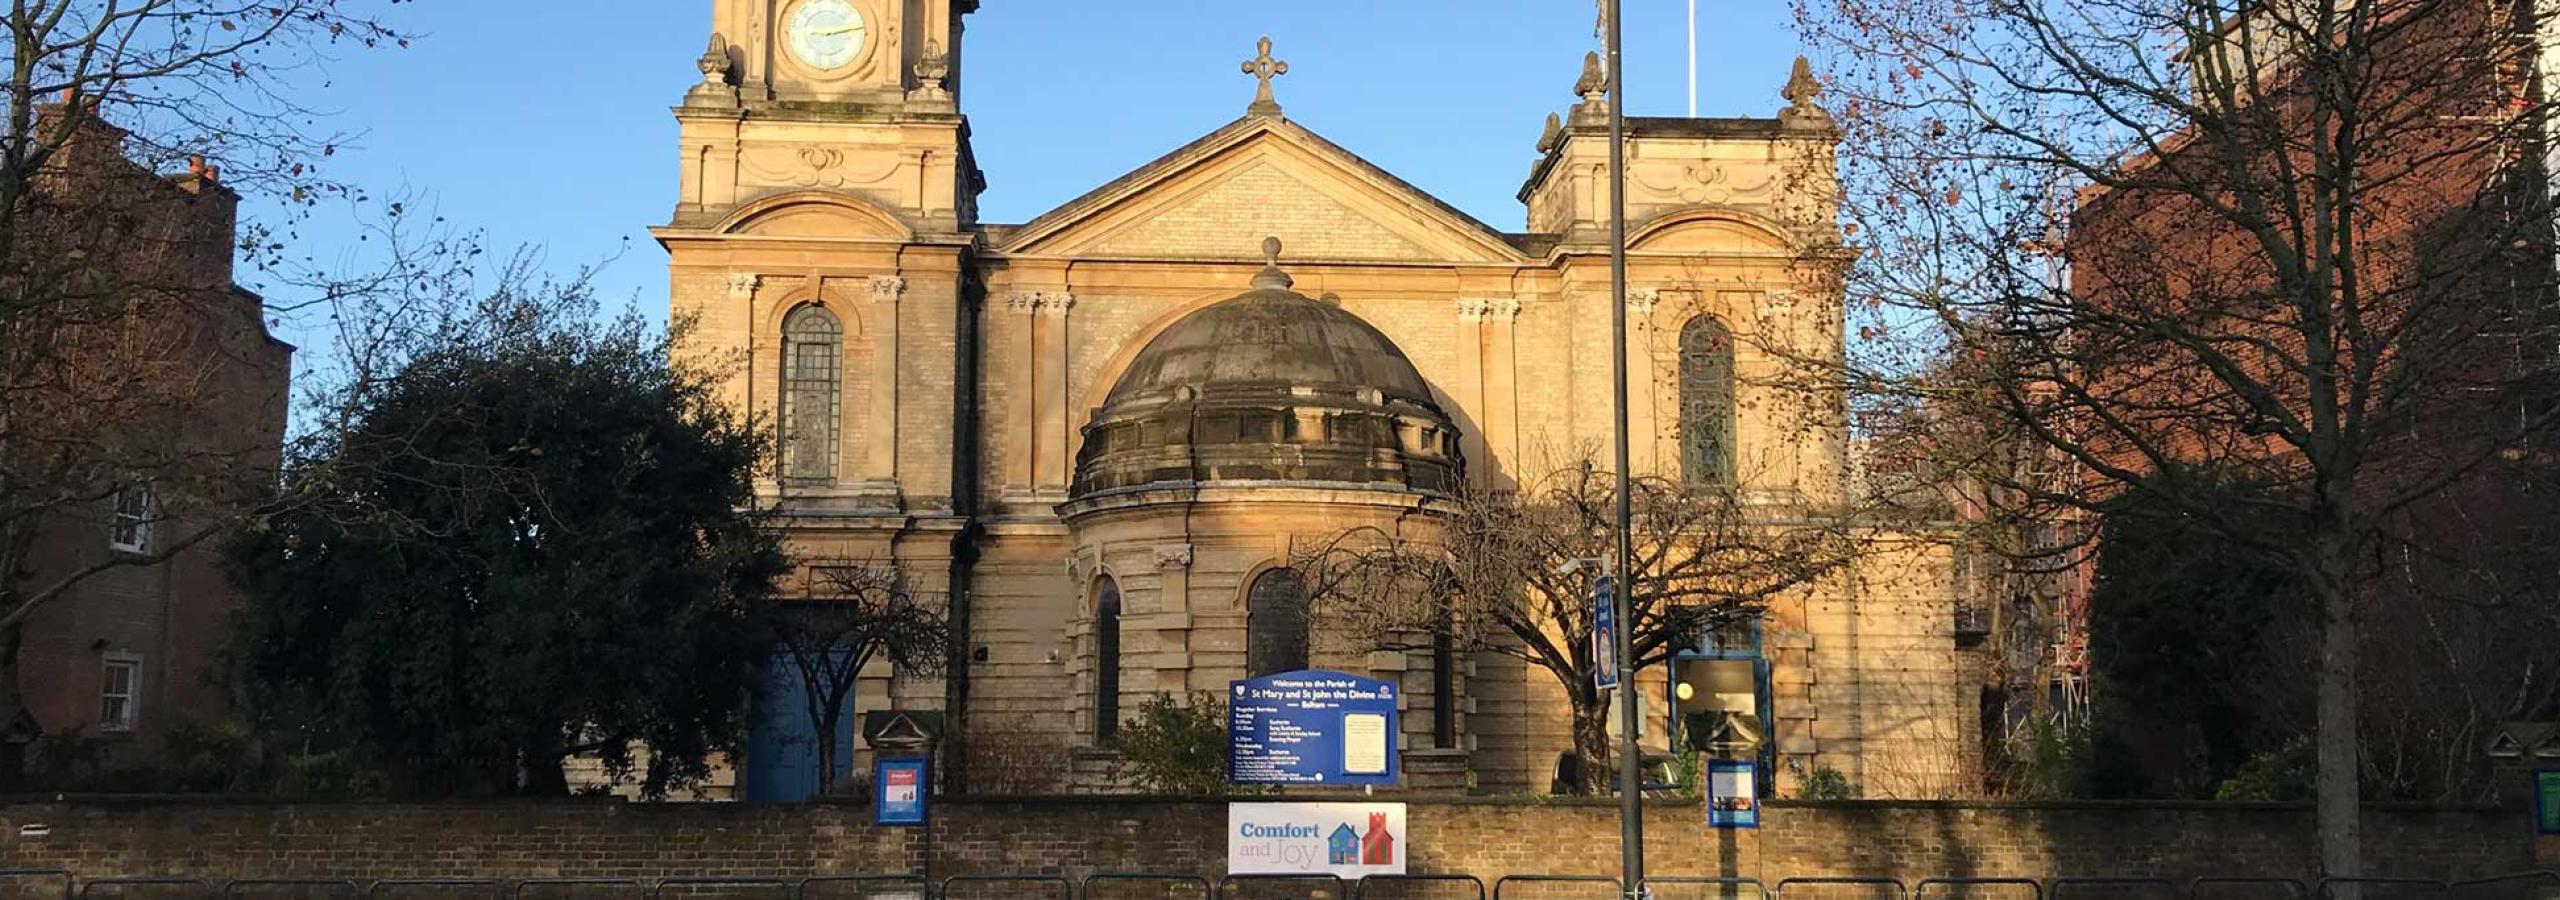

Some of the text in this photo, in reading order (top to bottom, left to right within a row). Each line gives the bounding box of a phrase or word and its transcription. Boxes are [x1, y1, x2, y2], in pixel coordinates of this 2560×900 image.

[1271, 679, 1356, 688] Welcome to the Parish of
[1251, 689, 1261, 699] St
[1262, 689, 1284, 700] Mary
[1285, 689, 1301, 699] and
[1302, 689, 1312, 699] St
[1312, 689, 1332, 700] John
[1333, 689, 1348, 699] the
[1348, 689, 1376, 699] Divine
[1241, 822, 1319, 838] Comfort
[1240, 840, 1319, 870] and Joy
